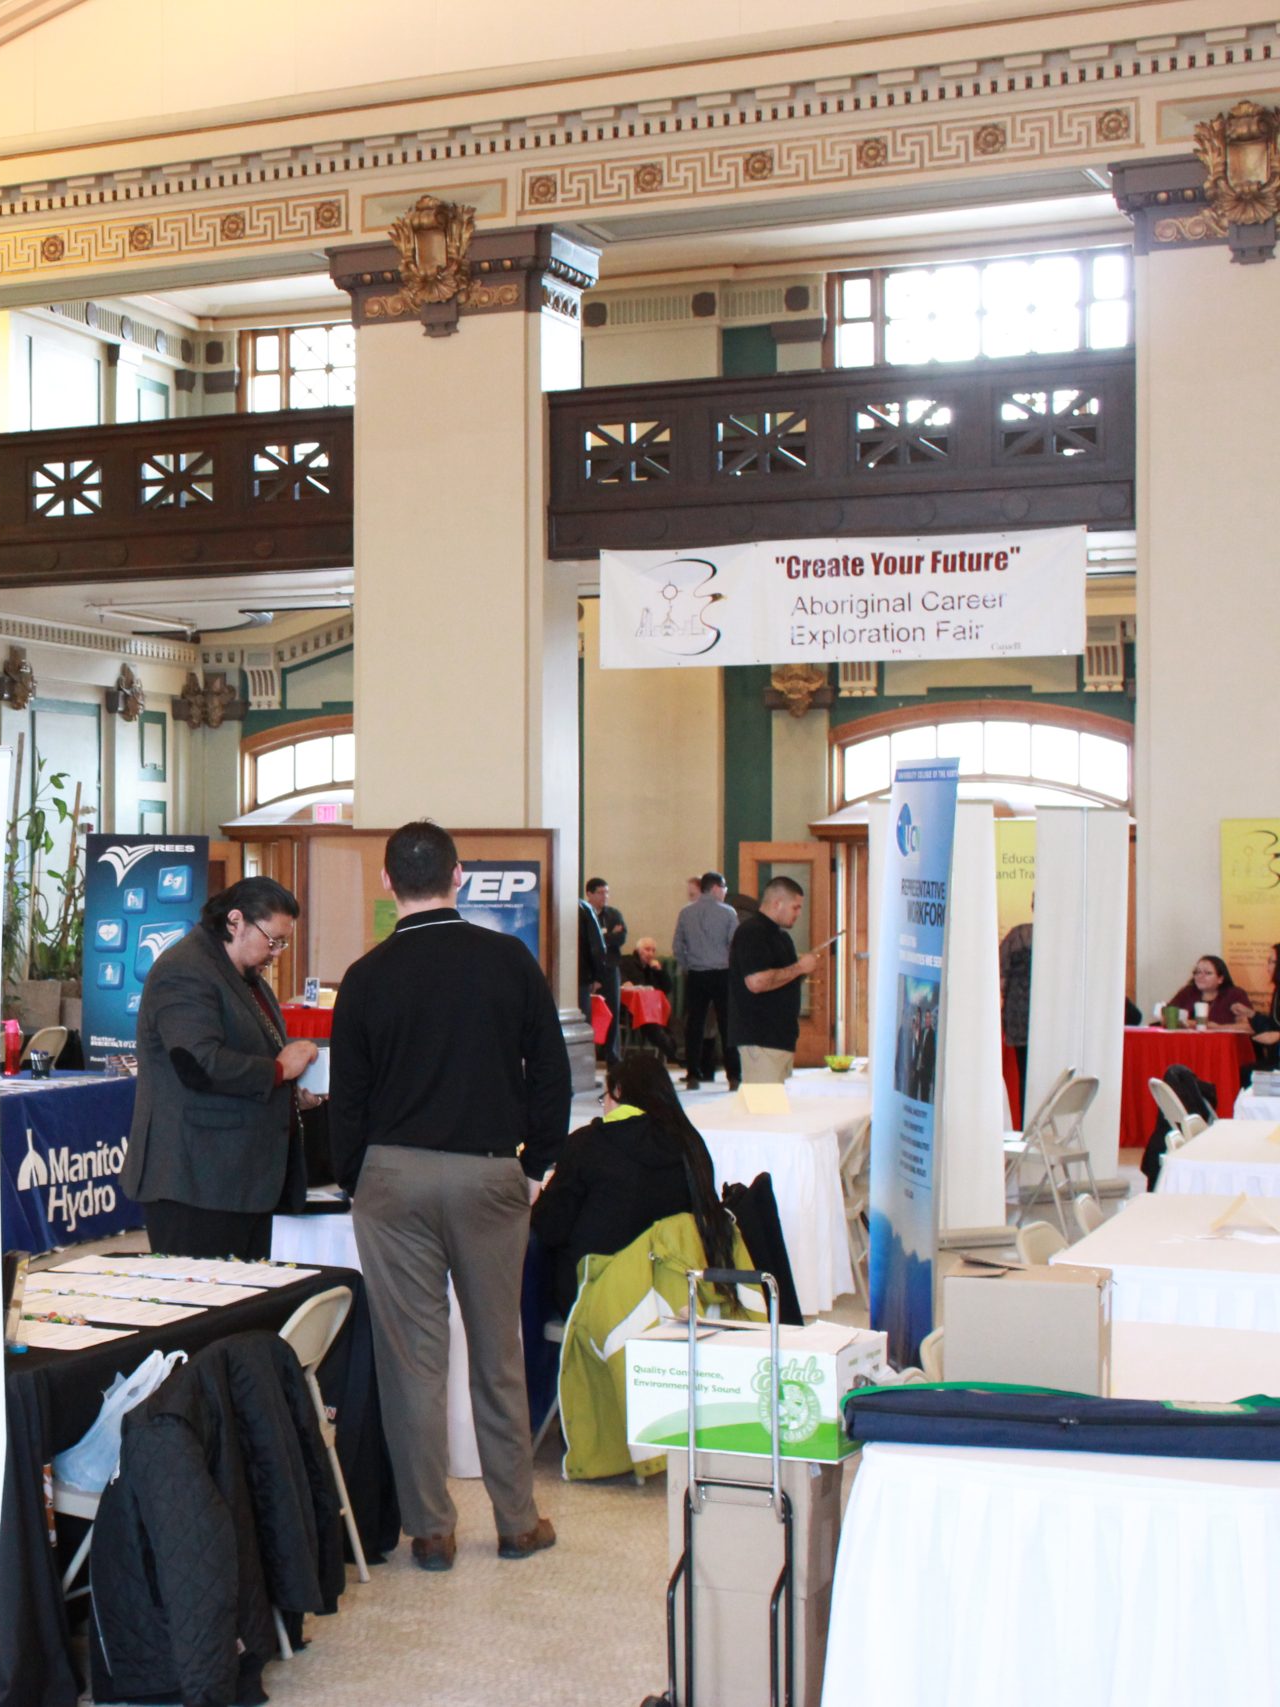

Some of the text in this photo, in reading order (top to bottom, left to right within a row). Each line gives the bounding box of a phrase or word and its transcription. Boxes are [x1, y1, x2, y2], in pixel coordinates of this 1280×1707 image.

[775, 546, 1022, 580] "Create Your Future"
[790, 590, 1007, 619] Aboriginal Career
[790, 620, 985, 650] Exploration Fair
[995, 867, 1017, 880] and
[47, 1180, 116, 1232] Hydro
[633, 1364, 667, 1376] Quality
[633, 1378, 742, 1395] Environmenally Sound
